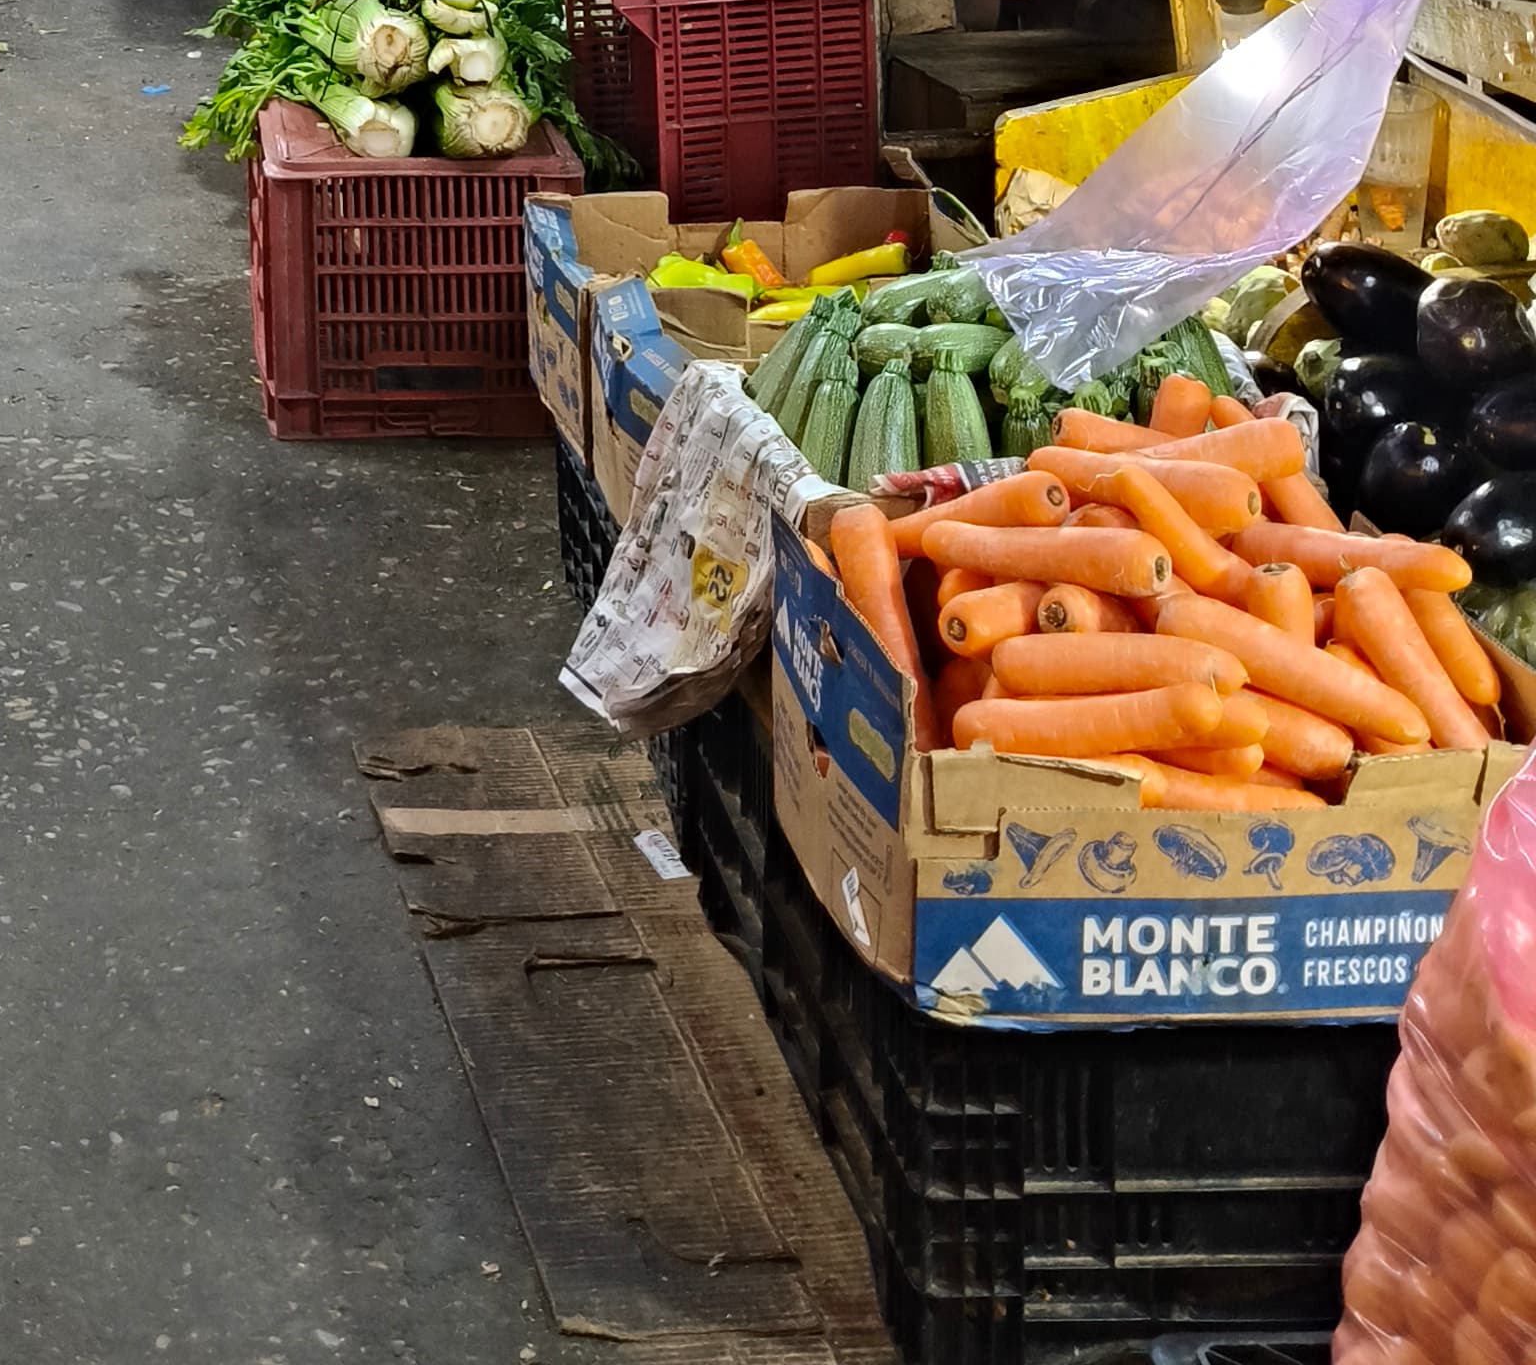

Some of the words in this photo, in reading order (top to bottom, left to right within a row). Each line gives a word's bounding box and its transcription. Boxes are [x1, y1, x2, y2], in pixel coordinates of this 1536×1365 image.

[1081, 914, 1277, 956] MONTE
[1080, 954, 1278, 998] BLANCO
[1302, 955, 1408, 988] FRESCOS
